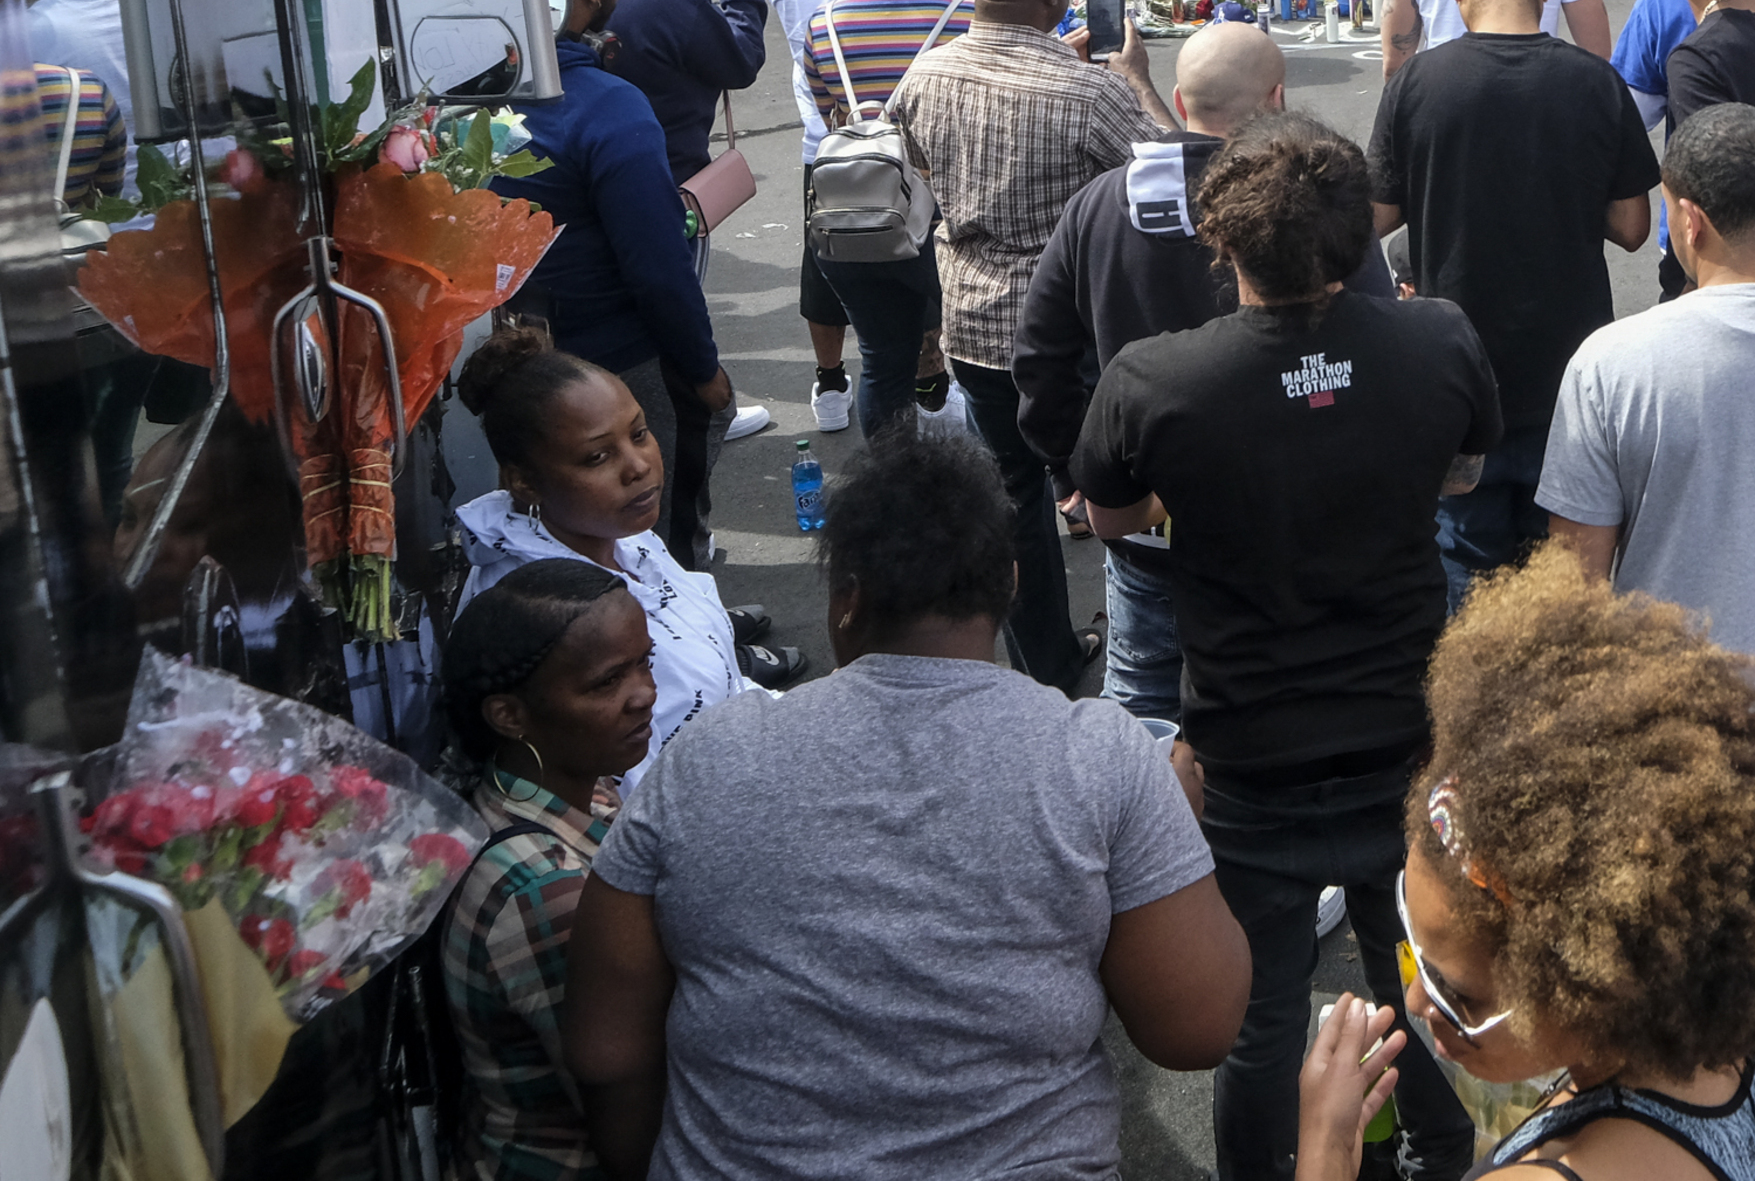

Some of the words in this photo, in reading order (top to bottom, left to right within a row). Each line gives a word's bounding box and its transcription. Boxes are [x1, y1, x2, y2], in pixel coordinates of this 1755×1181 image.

[1281, 360, 1352, 386] MARATHON
[1300, 352, 1326, 369] THE
[1286, 374, 1351, 398] CLOTHING
[683, 689, 703, 721] PINK
